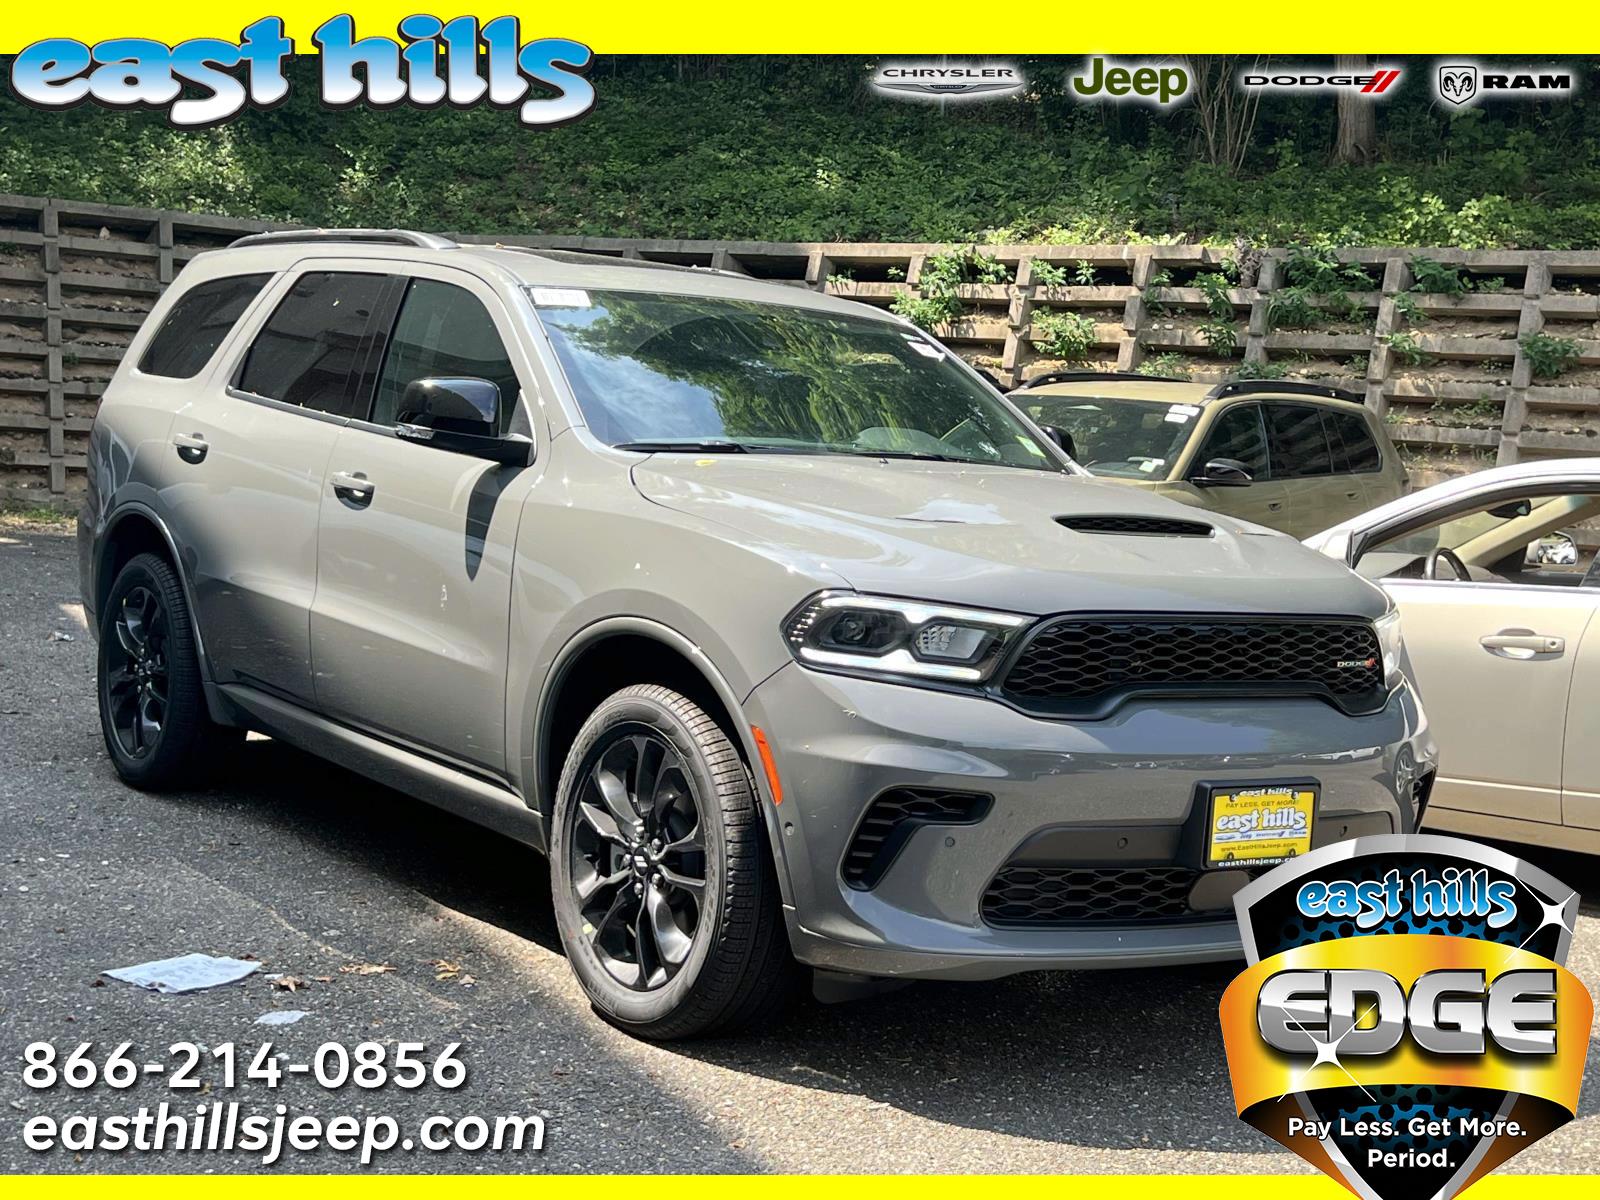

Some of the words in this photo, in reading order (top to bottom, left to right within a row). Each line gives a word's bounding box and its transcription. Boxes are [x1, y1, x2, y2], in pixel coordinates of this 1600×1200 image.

[1239, 789, 1266, 797] east
[1267, 787, 1293, 796] hills
[1216, 809, 1260, 833] east
[1261, 807, 1306, 830] hills
